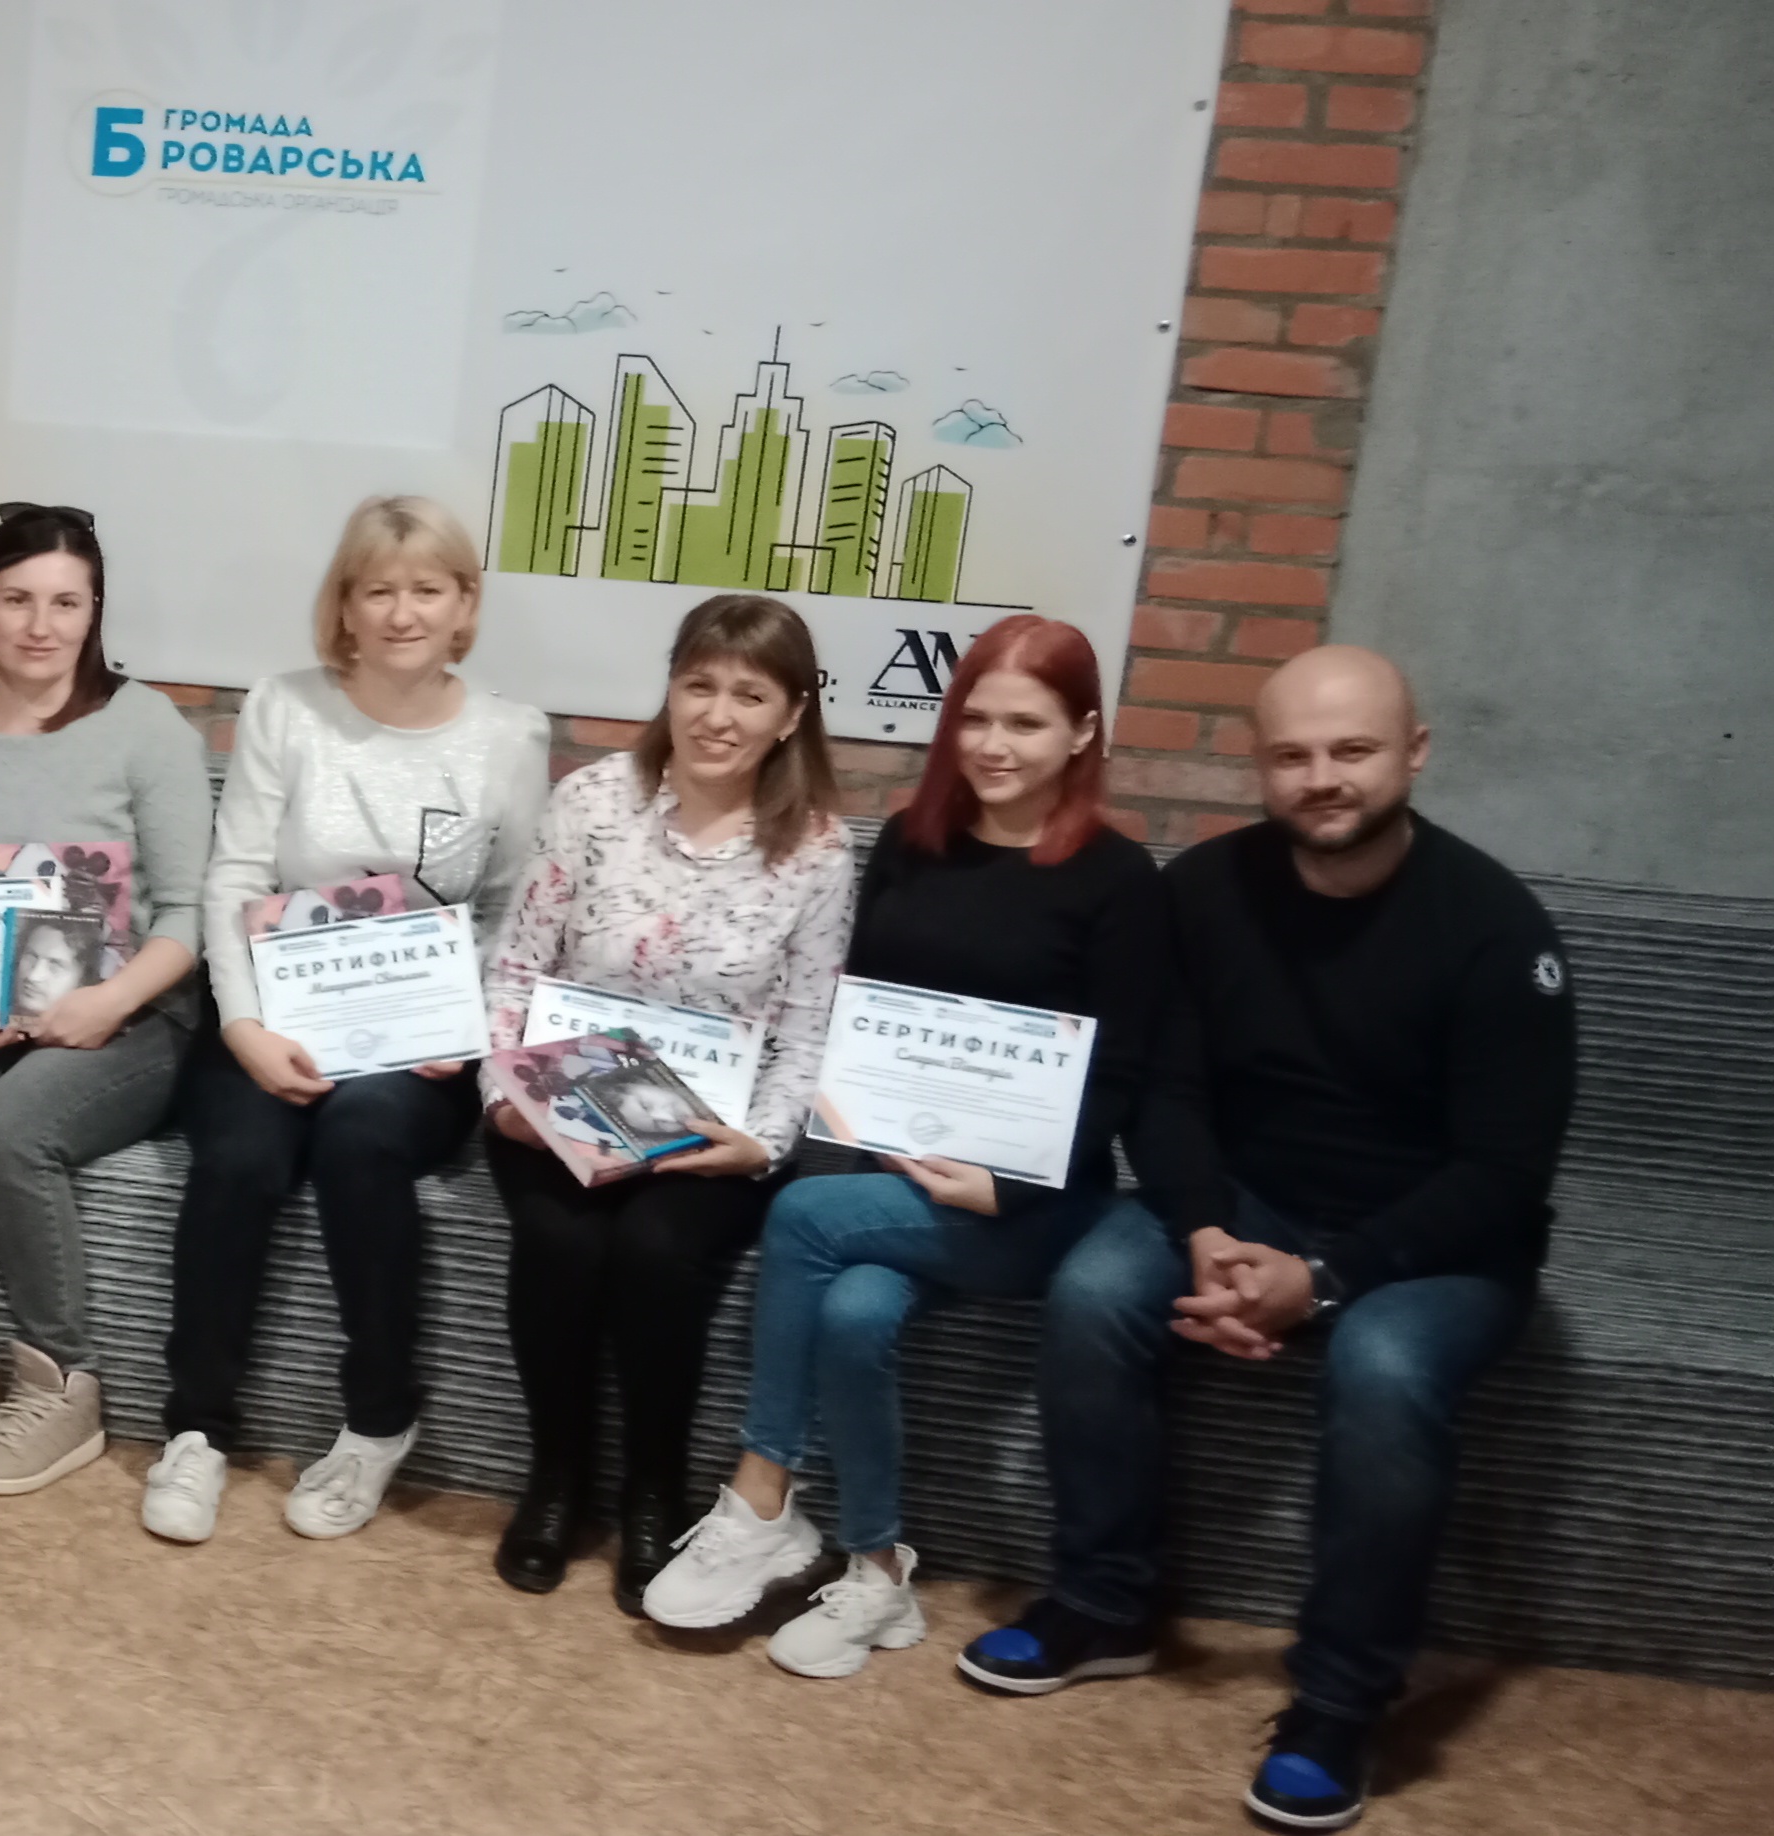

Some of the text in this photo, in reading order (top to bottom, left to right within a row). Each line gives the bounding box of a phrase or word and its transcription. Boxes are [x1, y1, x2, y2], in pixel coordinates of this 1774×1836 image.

[91, 106, 146, 178] Б
[162, 108, 314, 137] ГРОМАДА
[160, 140, 426, 183] РОВАРСЬКА
[867, 698, 937, 712] ALLIANCE
[275, 940, 459, 981] СЕРТИФІКАТ
[548, 1013, 742, 1068] СЕРФІКАТ
[852, 1016, 1071, 1068] СЕРТИФІКАТ
